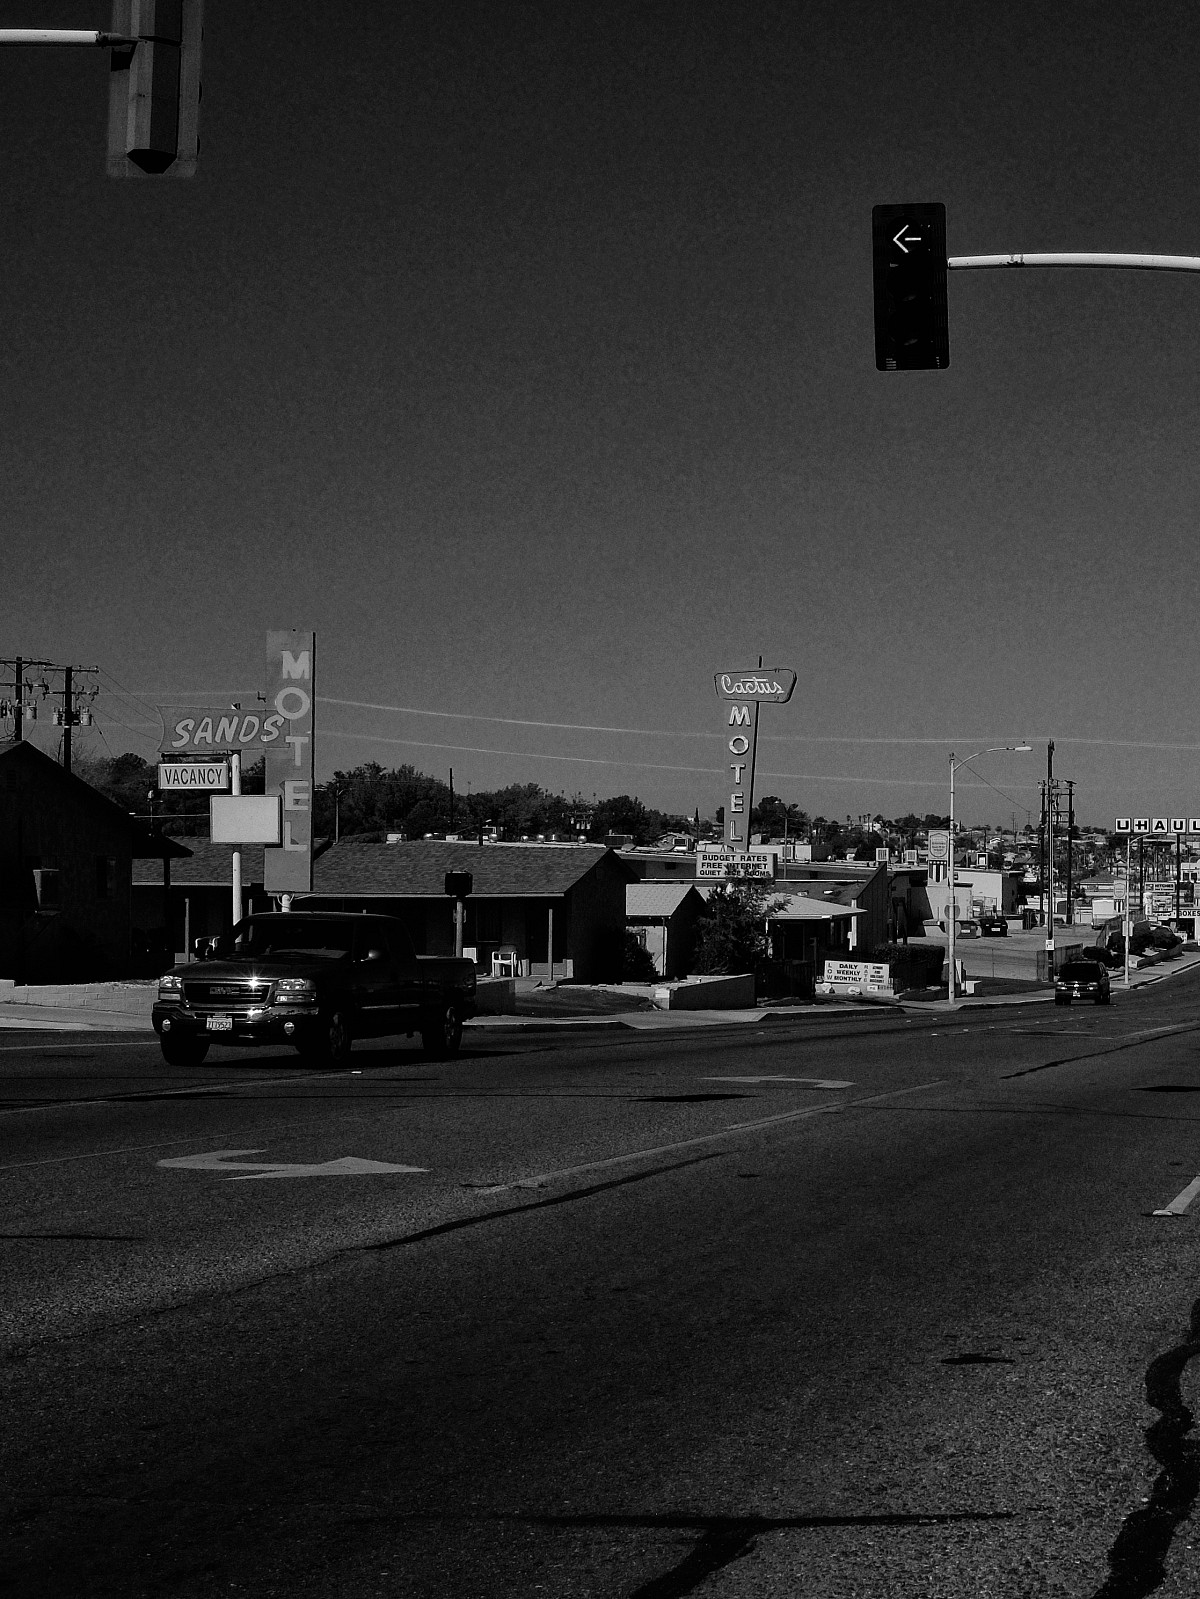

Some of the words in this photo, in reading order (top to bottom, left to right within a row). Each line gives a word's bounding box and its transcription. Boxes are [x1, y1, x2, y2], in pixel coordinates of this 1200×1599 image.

[721, 674, 785, 694] Cactus
[171, 715, 285, 748] SANDS
[275, 650, 310, 851] MOTEL
[164, 768, 223, 785] VACANCY
[728, 705, 751, 842] MOTEL
